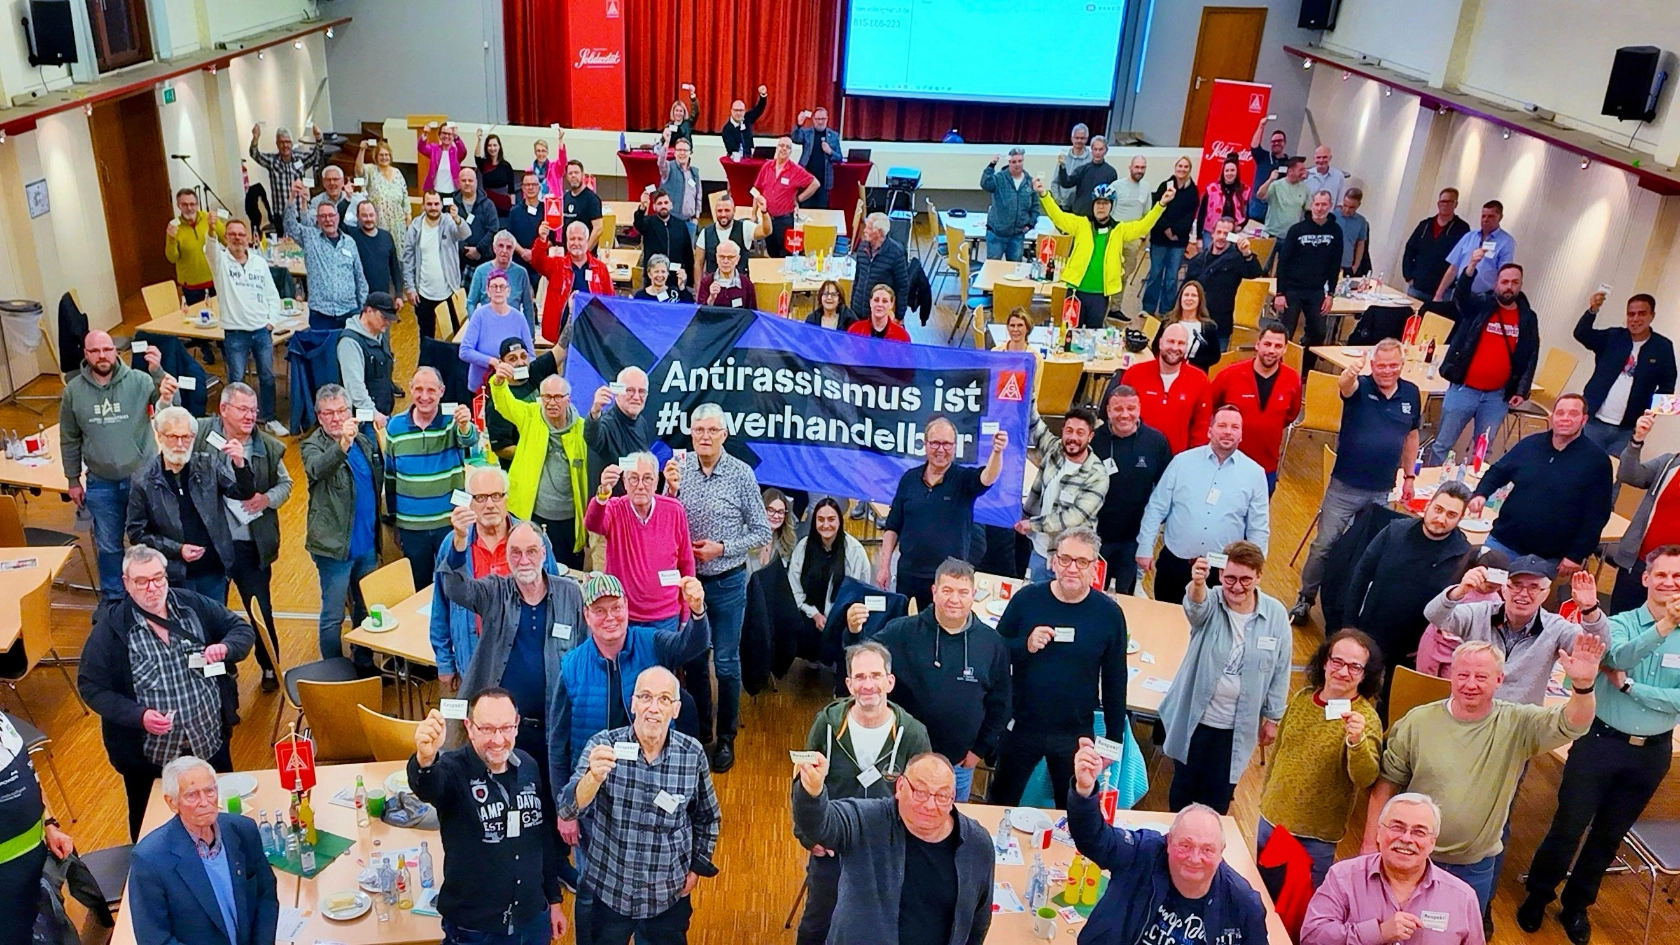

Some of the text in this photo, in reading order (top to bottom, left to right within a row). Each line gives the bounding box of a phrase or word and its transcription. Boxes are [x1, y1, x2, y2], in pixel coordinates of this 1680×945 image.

[660, 356, 982, 413] Antirassismus ist
[655, 401, 973, 459] #uverhandelbr
[483, 821, 505, 832] EST.
